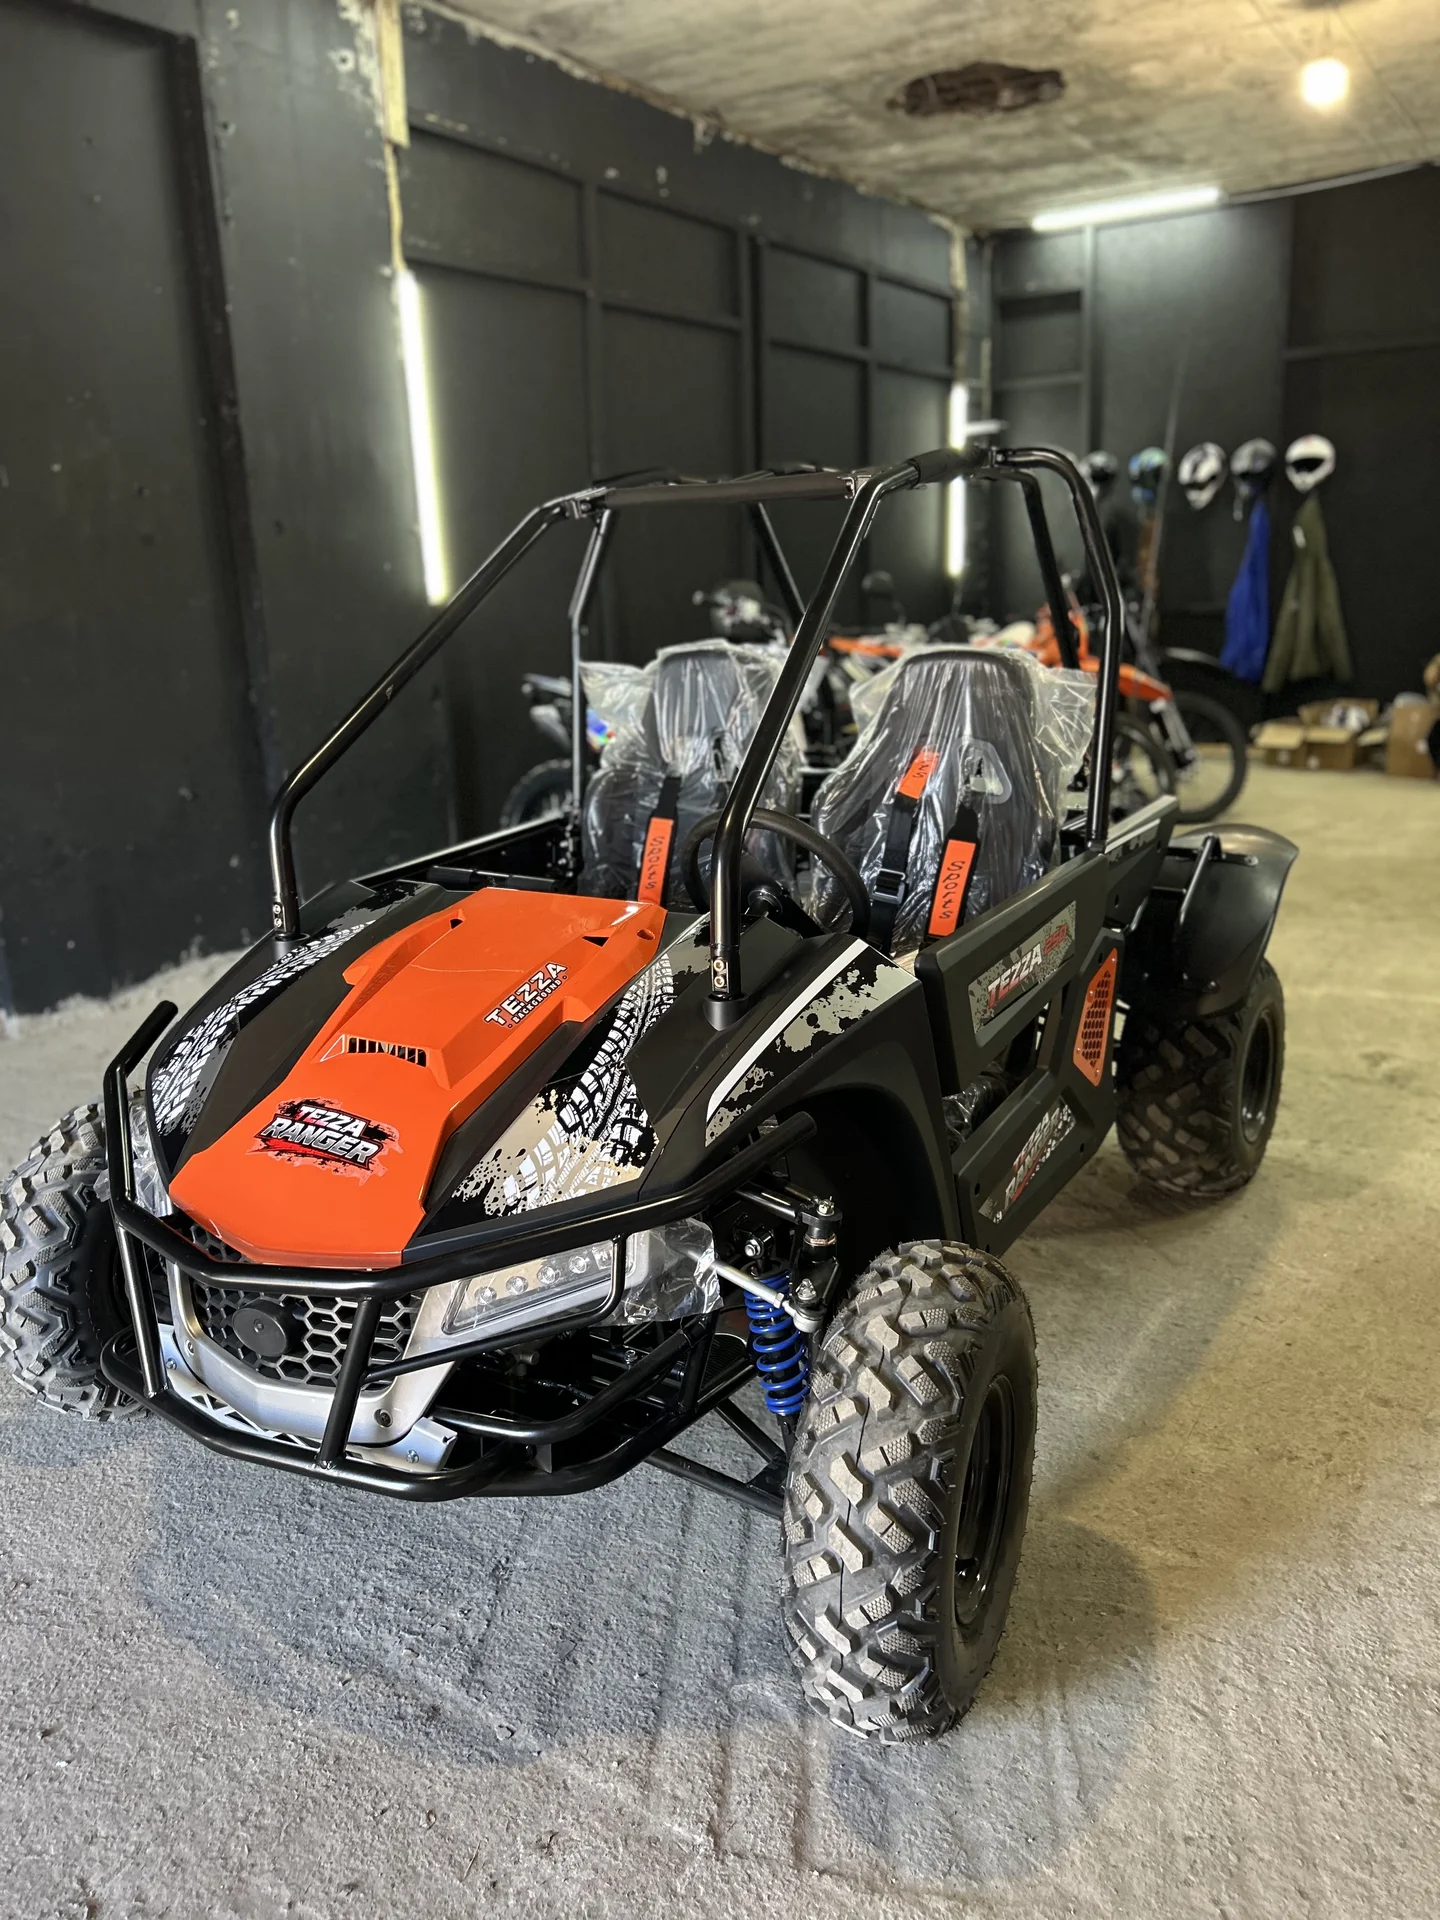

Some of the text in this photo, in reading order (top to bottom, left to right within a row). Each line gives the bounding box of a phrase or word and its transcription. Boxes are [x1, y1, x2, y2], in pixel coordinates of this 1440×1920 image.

[483, 962, 568, 1027] TEZZA
[511, 978, 563, 1024] BACKGROUND
[987, 943, 1043, 1011] TEZZA
[260, 1116, 380, 1164] RANGER
[295, 1104, 367, 1138] TEZZA
